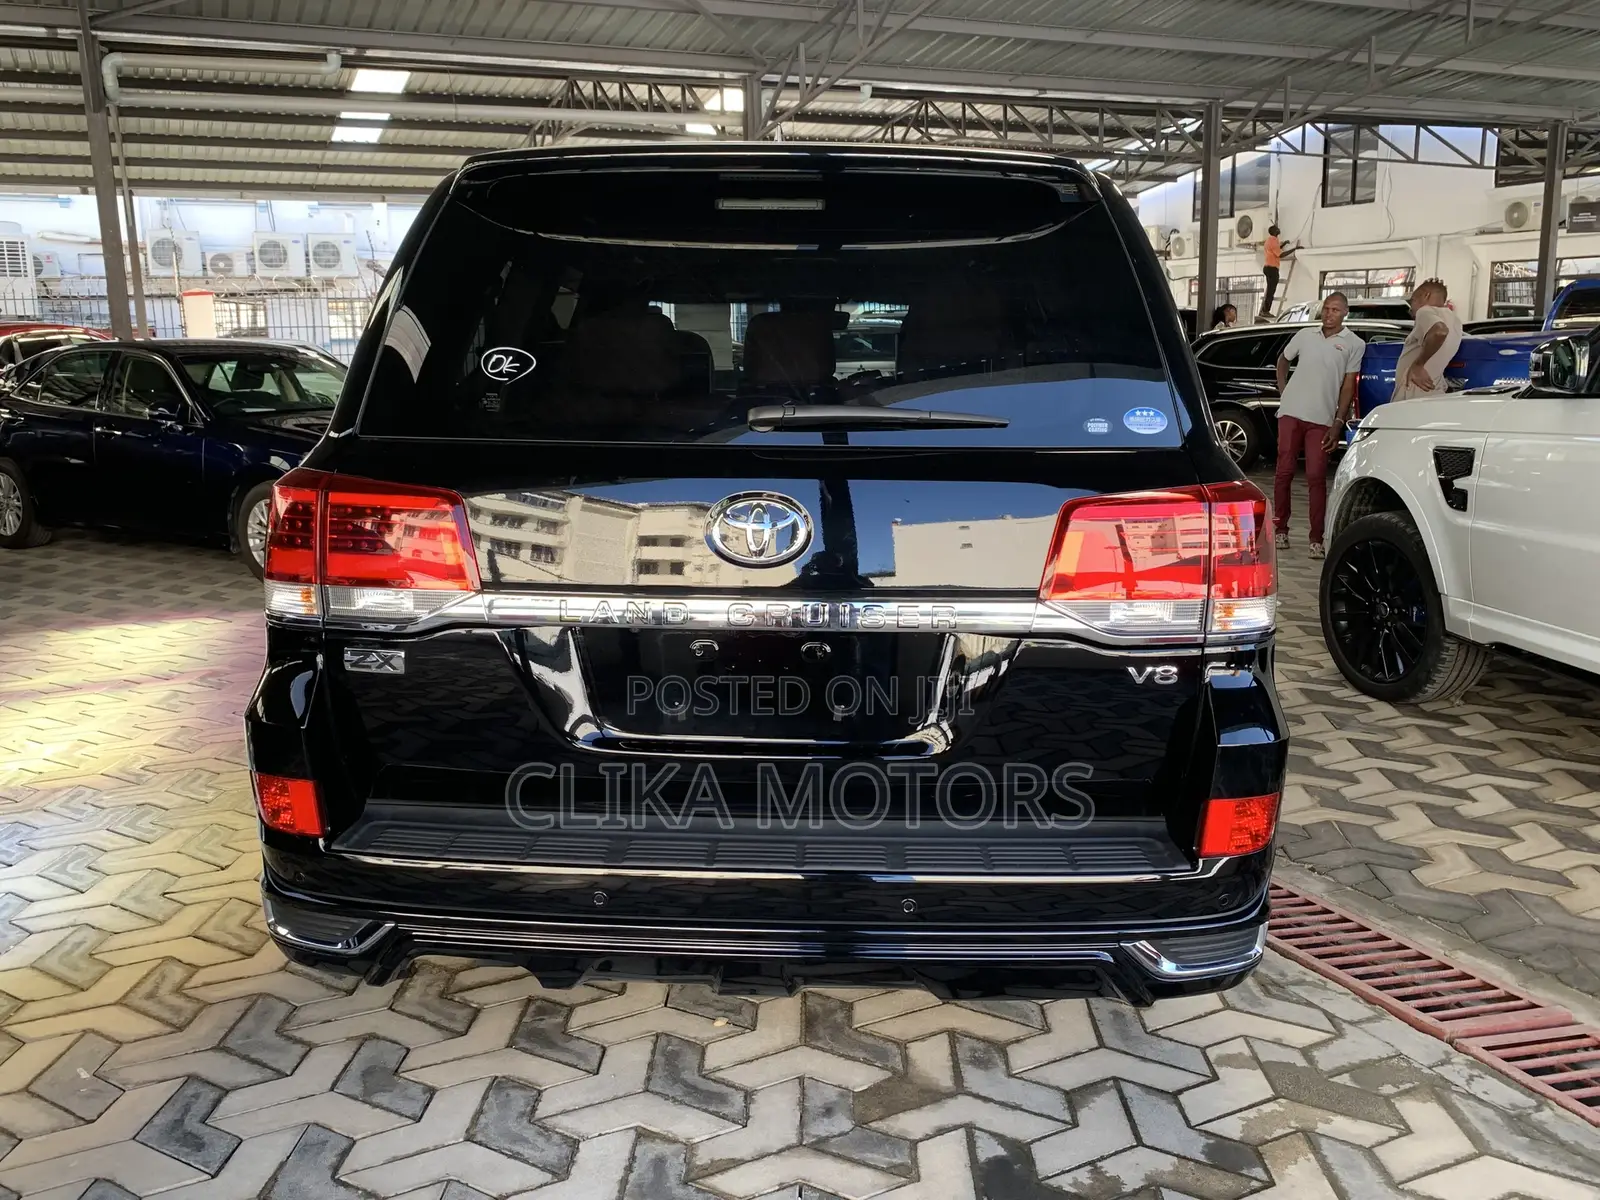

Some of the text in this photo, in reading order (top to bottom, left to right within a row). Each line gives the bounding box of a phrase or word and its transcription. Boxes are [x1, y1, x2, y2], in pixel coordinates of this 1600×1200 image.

[559, 600, 959, 629] LAND CRUISER
[345, 649, 402, 672] ZX
[1126, 665, 1178, 685] V8
